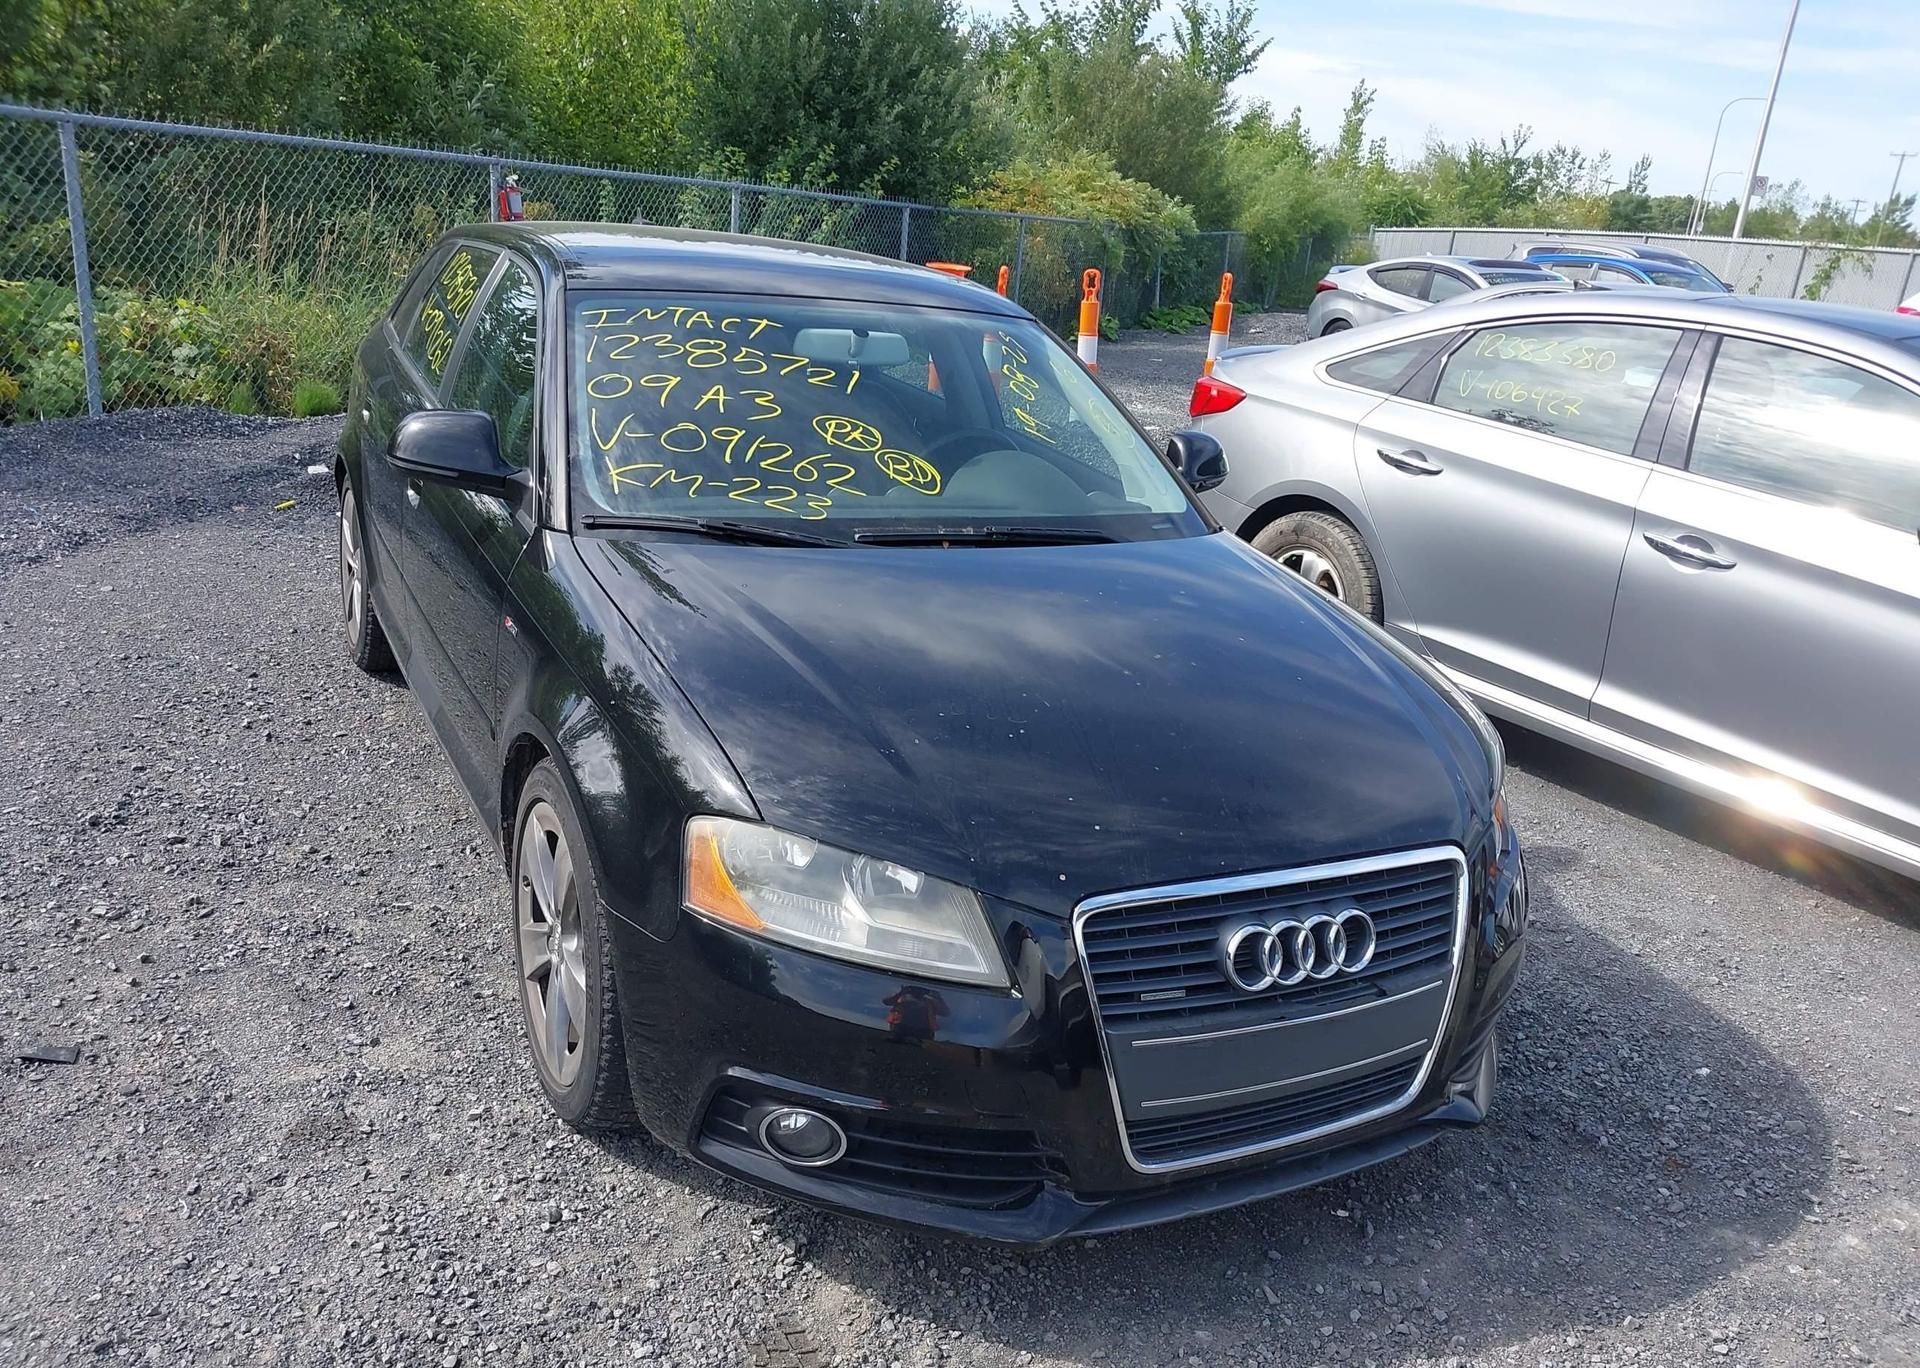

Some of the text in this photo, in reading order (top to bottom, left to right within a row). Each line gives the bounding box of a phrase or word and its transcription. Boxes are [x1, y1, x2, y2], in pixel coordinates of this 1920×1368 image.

[581, 307, 784, 340] INTACT
[586, 334, 860, 394] 12385721
[587, 373, 782, 420] 09 A3
[591, 408, 867, 497] V-091262
[604, 455, 832, 520] KM-223
